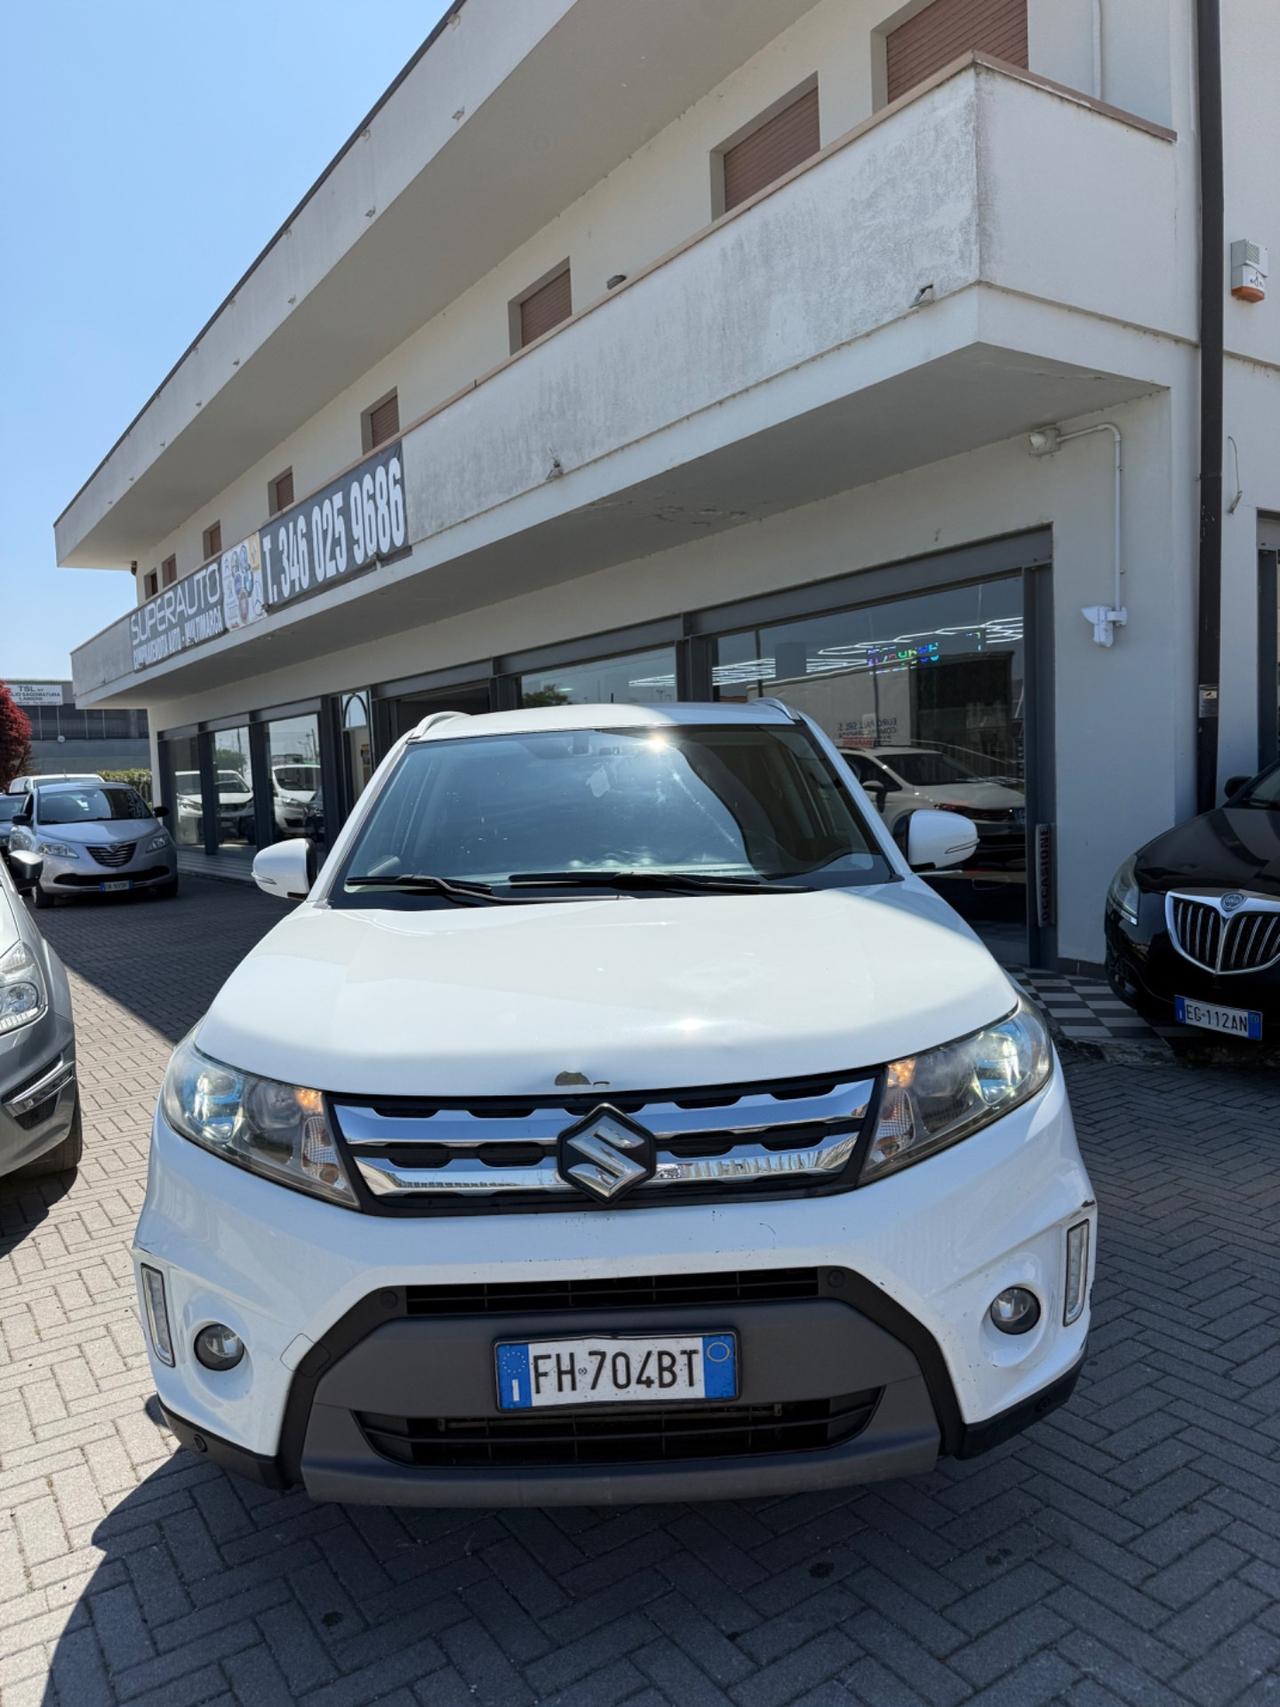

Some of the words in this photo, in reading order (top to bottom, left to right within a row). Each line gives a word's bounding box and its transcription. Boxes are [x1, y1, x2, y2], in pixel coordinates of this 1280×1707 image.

[279, 515, 310, 599] 346
[312, 491, 348, 583] 025
[350, 457, 405, 565] 9686
[130, 563, 220, 646] SUPERAUTO
